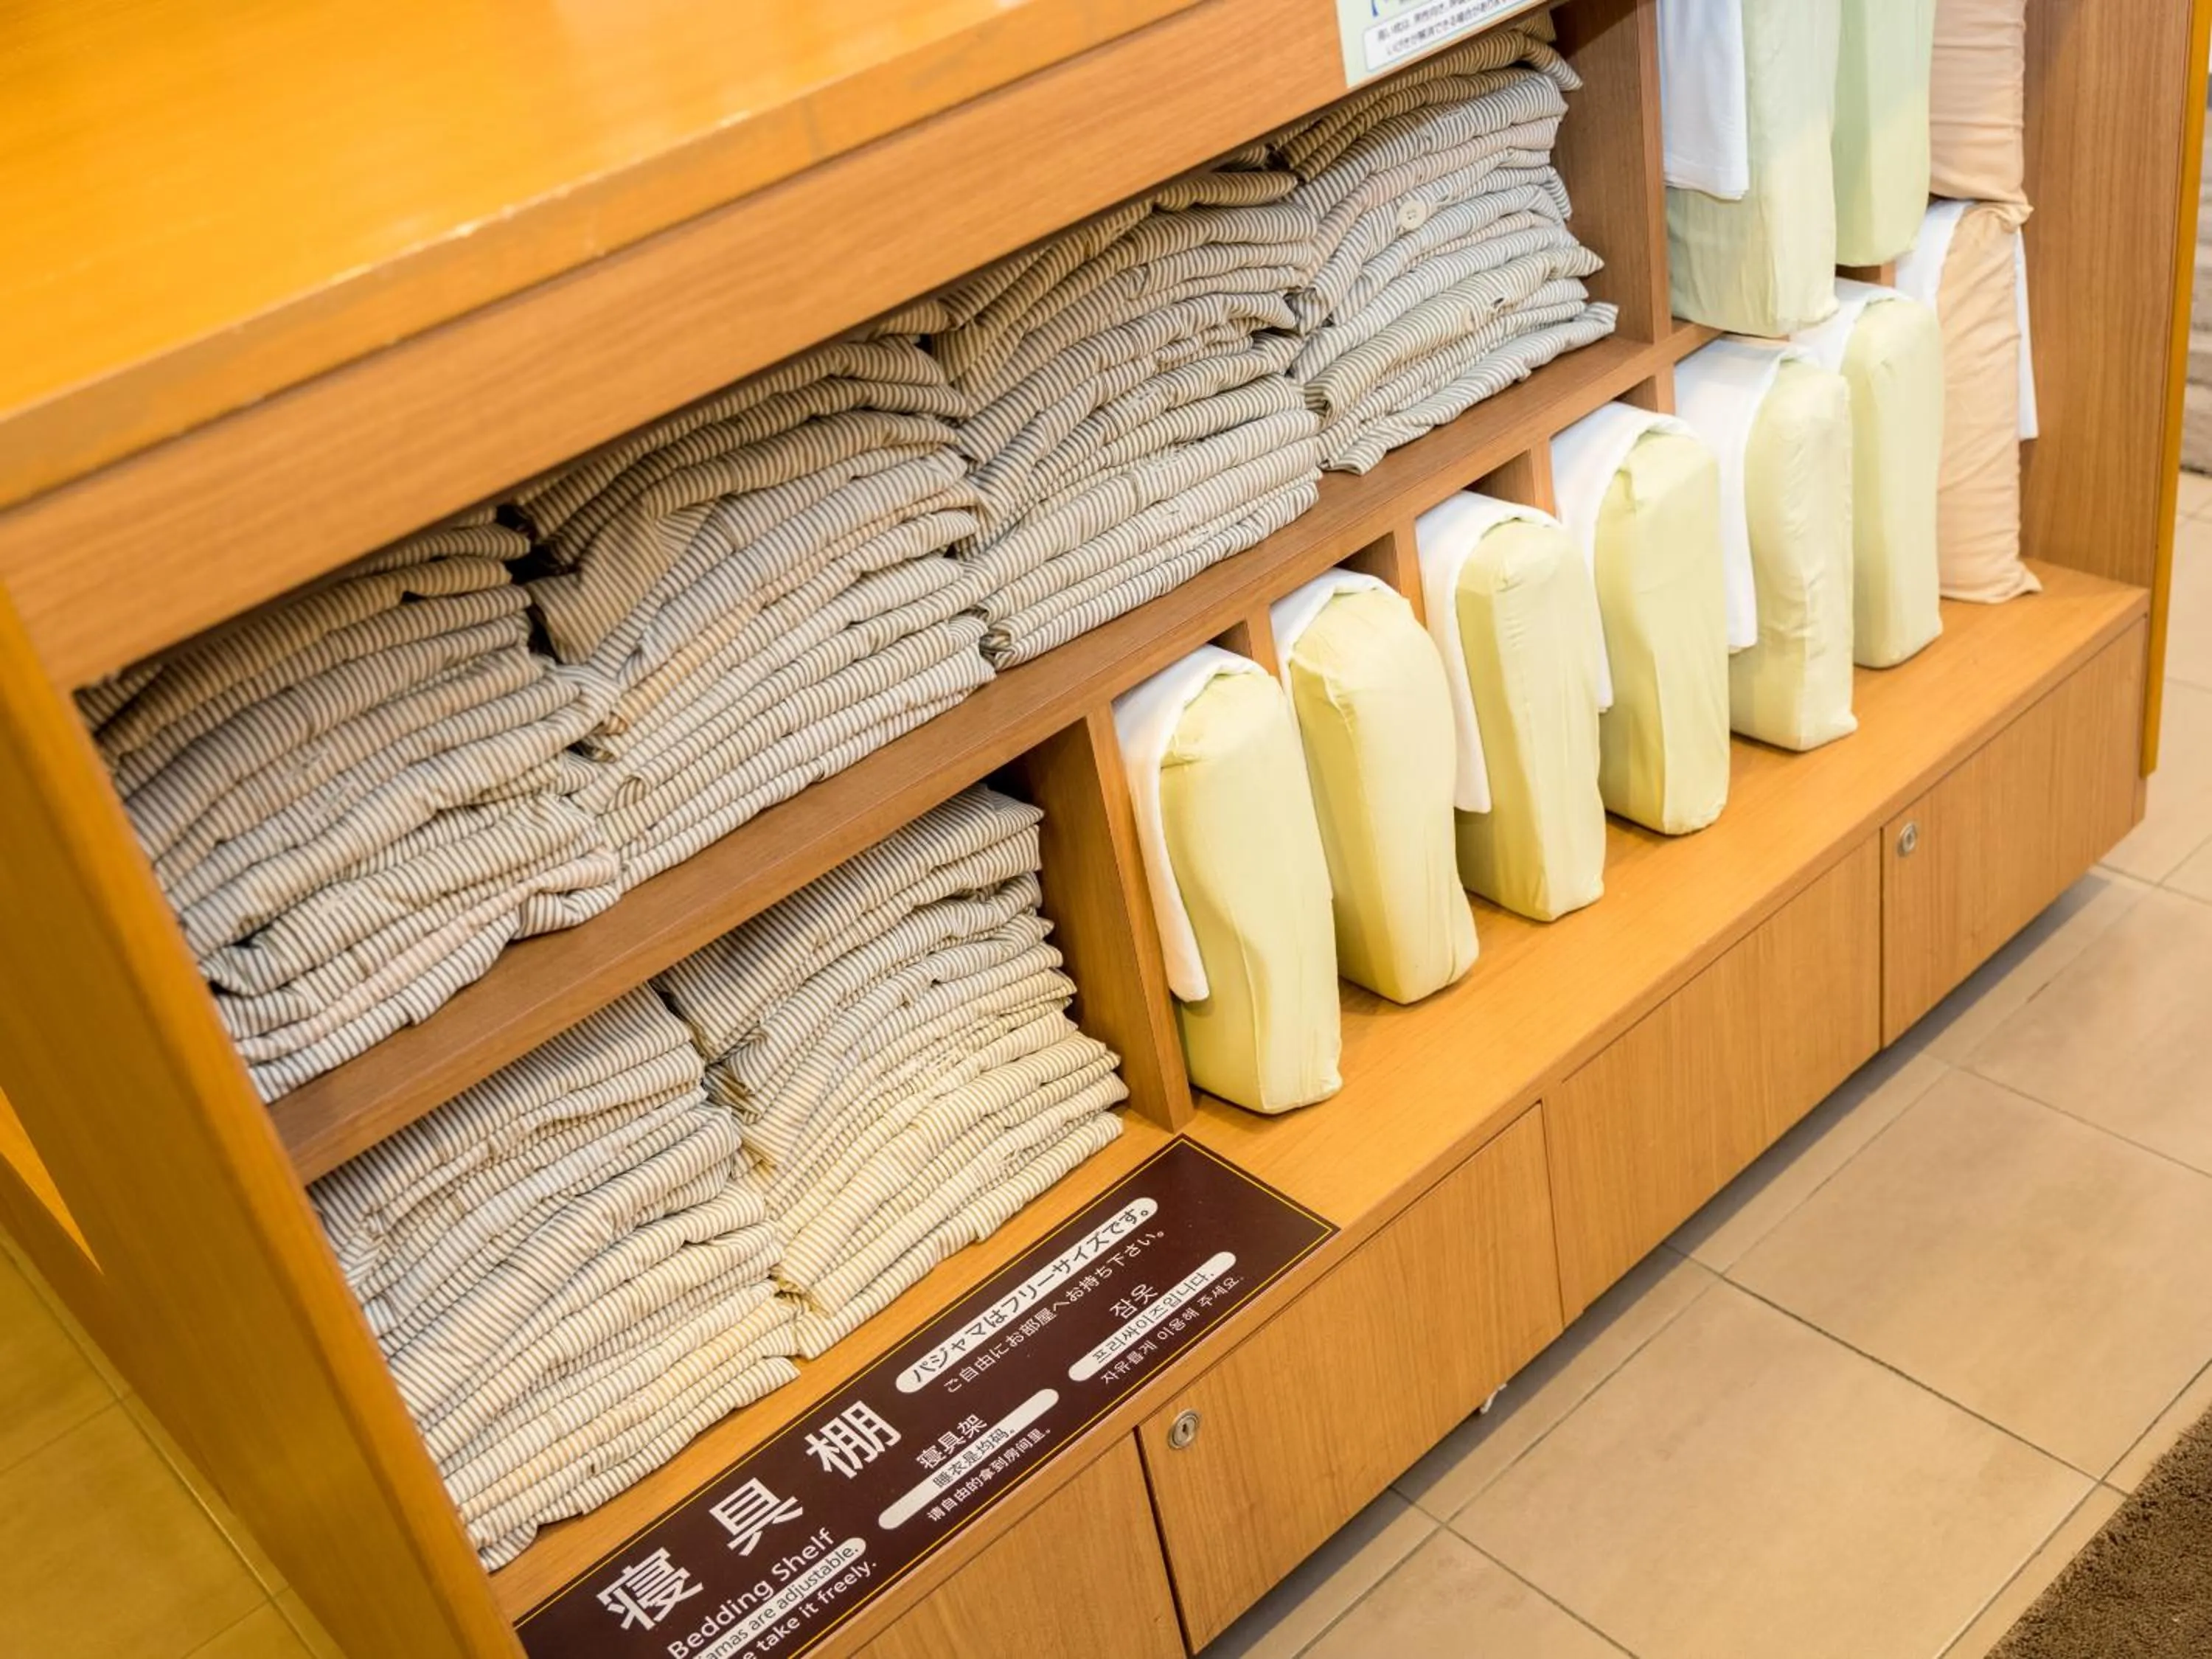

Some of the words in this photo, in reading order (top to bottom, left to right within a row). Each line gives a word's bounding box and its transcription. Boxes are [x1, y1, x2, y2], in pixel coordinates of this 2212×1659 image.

[914, 1208, 1150, 1383] パジャマはフリーサイズです。
[944, 1231, 1165, 1393] ご自由にお部屋へお持ち下さい。
[1092, 1273, 1215, 1363] 프리싸이즈입니다.
[1109, 1284, 1158, 1319] 잠옷
[1157, 1307, 1200, 1340] 이용해
[596, 1400, 901, 1631] 寝具棚
[667, 1580, 774, 1659] Bedding
[771, 1527, 834, 1582] Shelf
[698, 1629, 748, 1659] amas
[748, 1607, 776, 1630] are
[776, 1547, 858, 1610] adjustable.
[757, 1617, 801, 1652] take
[799, 1602, 819, 1618] it
[818, 1561, 877, 1604] freely.
